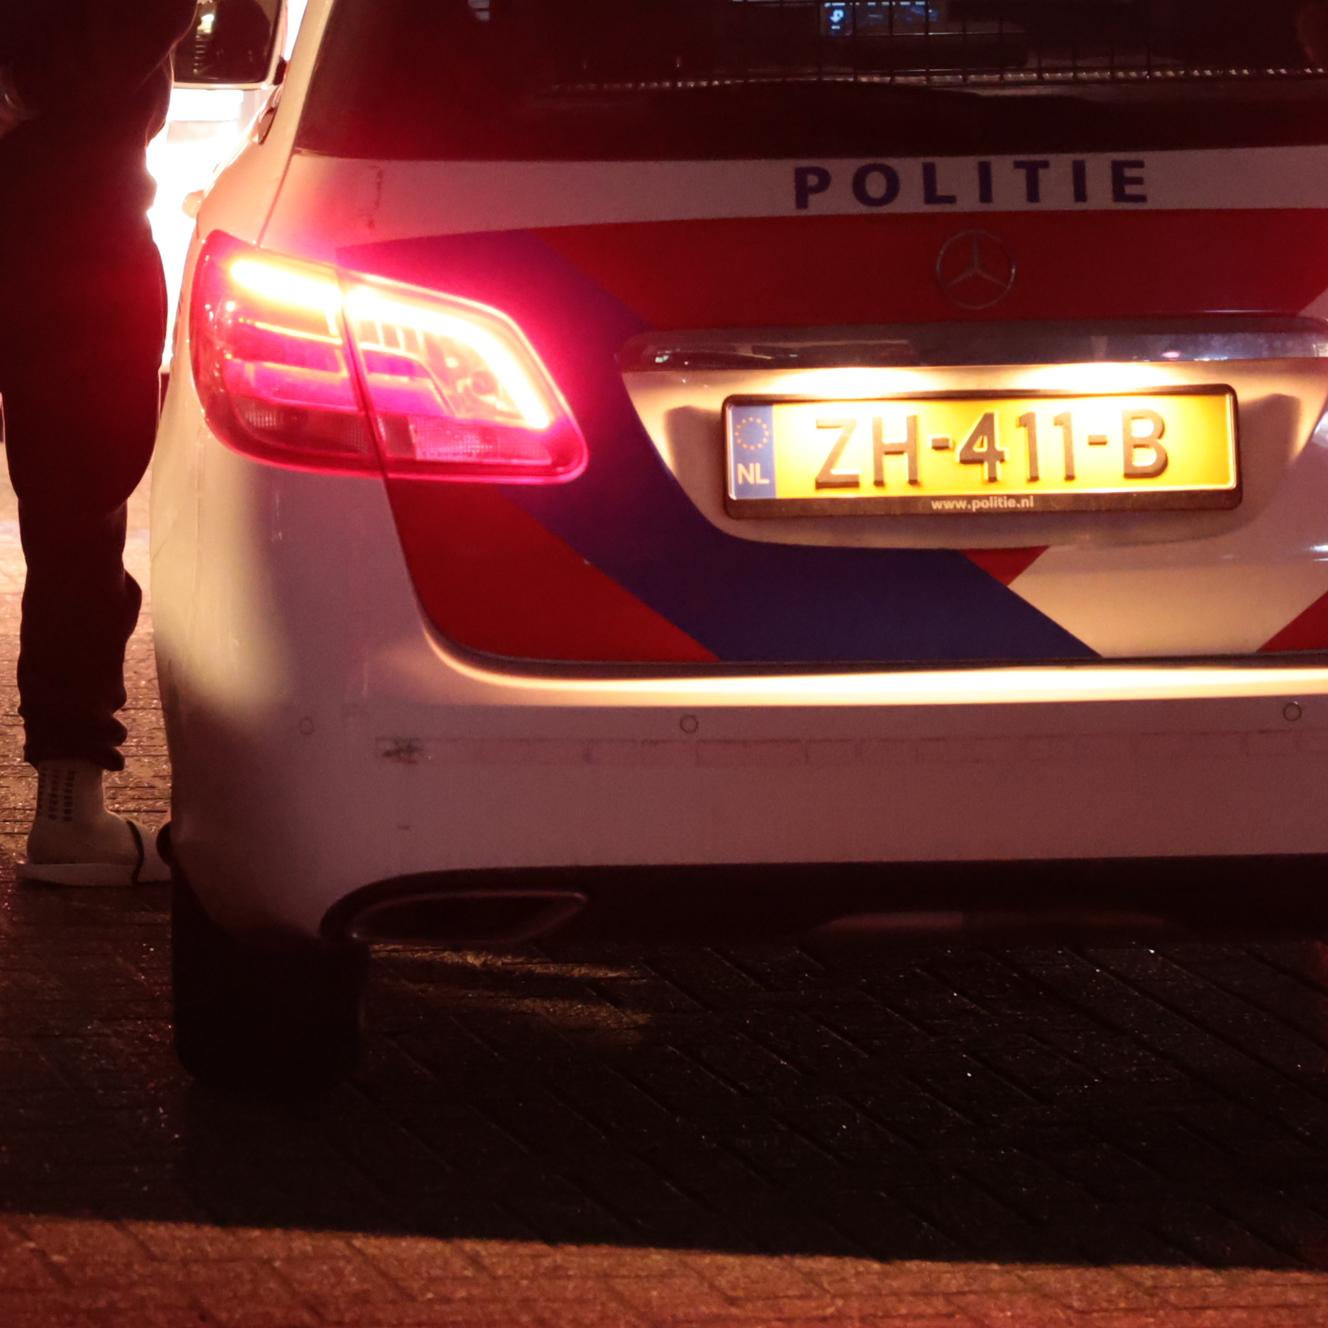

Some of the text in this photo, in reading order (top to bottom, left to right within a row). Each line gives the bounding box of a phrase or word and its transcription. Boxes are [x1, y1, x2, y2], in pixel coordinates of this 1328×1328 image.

[794, 159, 1148, 210] POLITIE
[815, 408, 1169, 490] ZH-411-B
[736, 462, 770, 486] NL
[930, 495, 1035, 513] www.politie.nl
